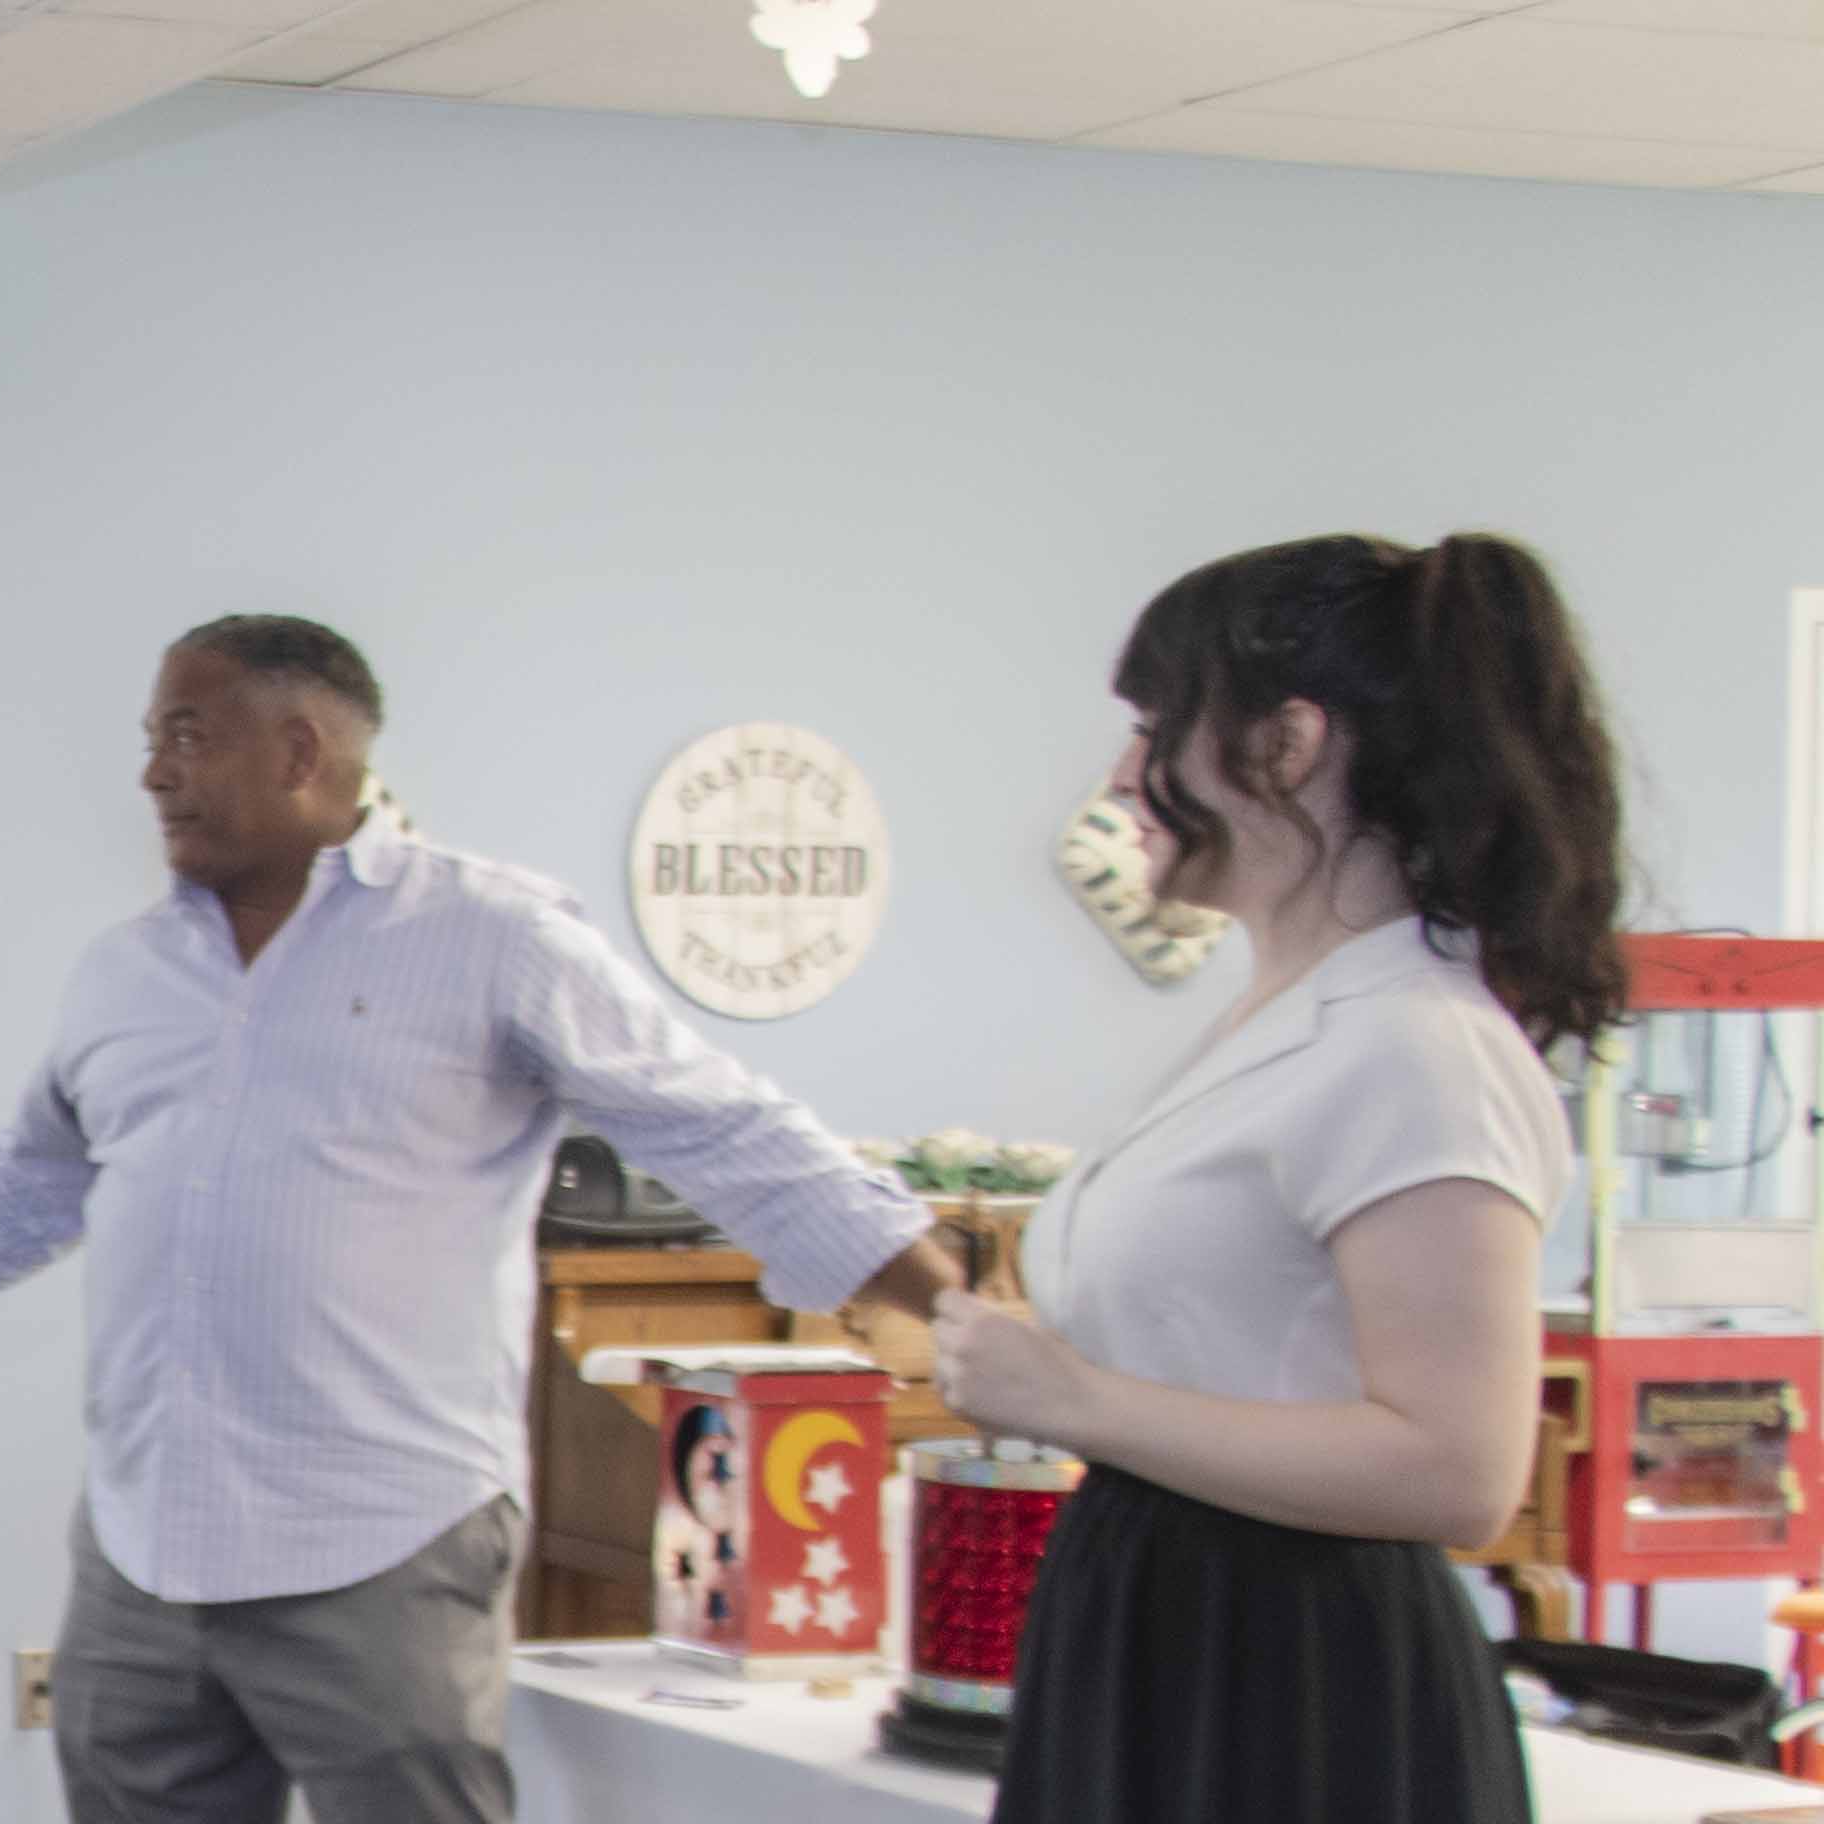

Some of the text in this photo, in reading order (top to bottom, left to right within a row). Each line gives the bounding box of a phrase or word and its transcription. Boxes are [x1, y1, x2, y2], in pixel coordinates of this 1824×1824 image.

[676, 747, 848, 818] GRATEFUL
[652, 843, 868, 897] BLESSED
[679, 930, 848, 992] THANKFUL
